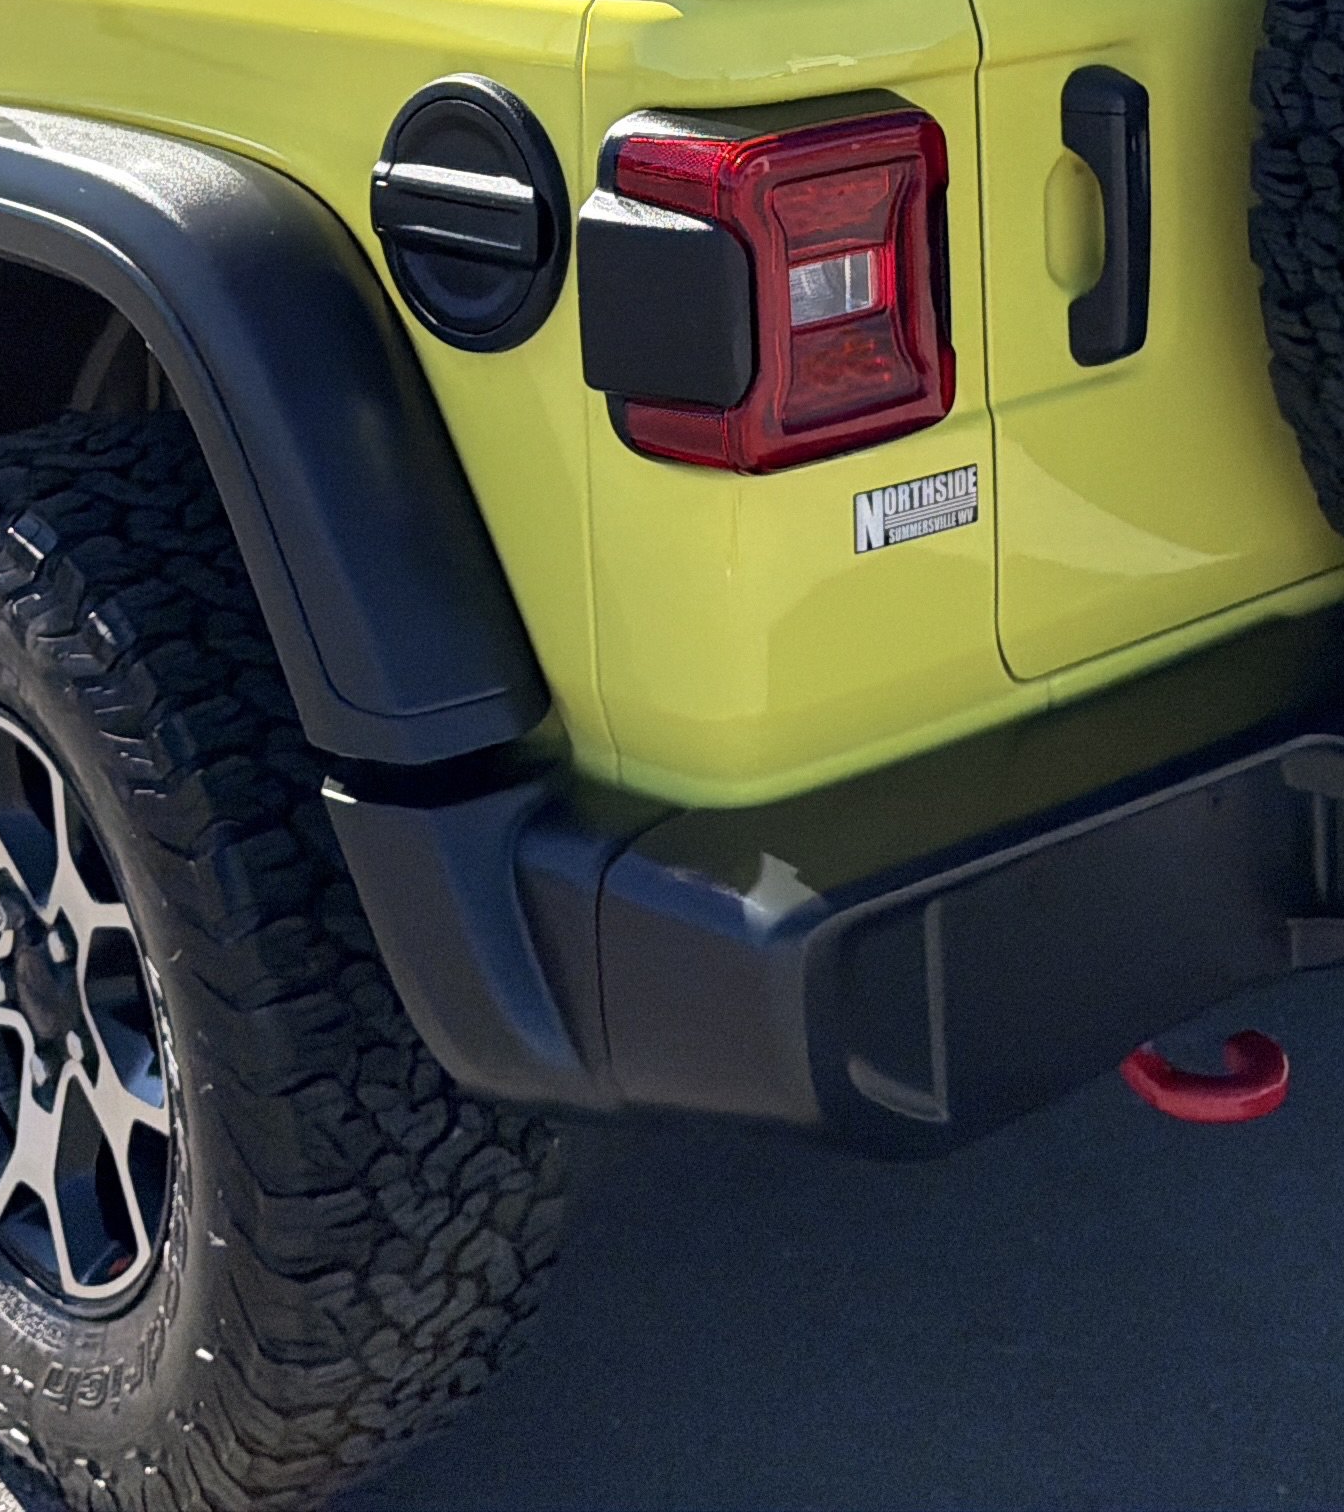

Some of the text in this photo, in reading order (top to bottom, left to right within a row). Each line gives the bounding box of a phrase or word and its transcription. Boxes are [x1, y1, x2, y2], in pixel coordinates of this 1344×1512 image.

[855, 466, 977, 553] NORTHSIDE
[888, 507, 974, 544] SUMMERSVILLE WV
